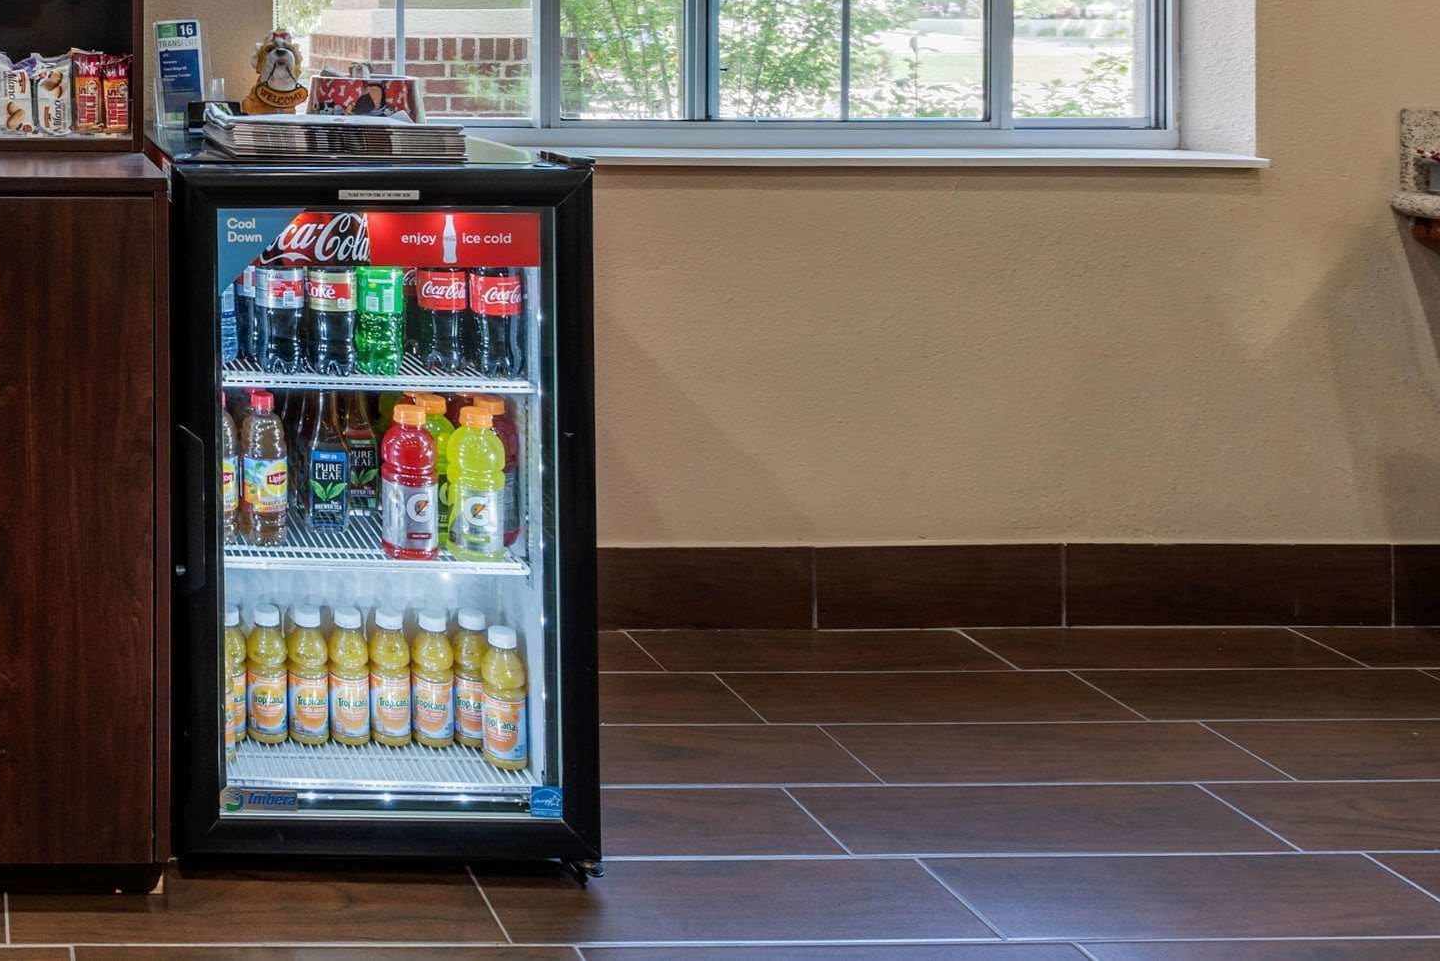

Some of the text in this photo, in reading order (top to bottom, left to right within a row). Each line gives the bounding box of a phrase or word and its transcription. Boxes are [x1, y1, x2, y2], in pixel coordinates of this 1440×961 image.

[179, 24, 193, 36] 16
[227, 217, 256, 229] Cool
[227, 231, 262, 242] Down
[400, 232, 437, 246] enjoy
[462, 232, 512, 244] ice cold
[315, 463, 341, 472] PURE
